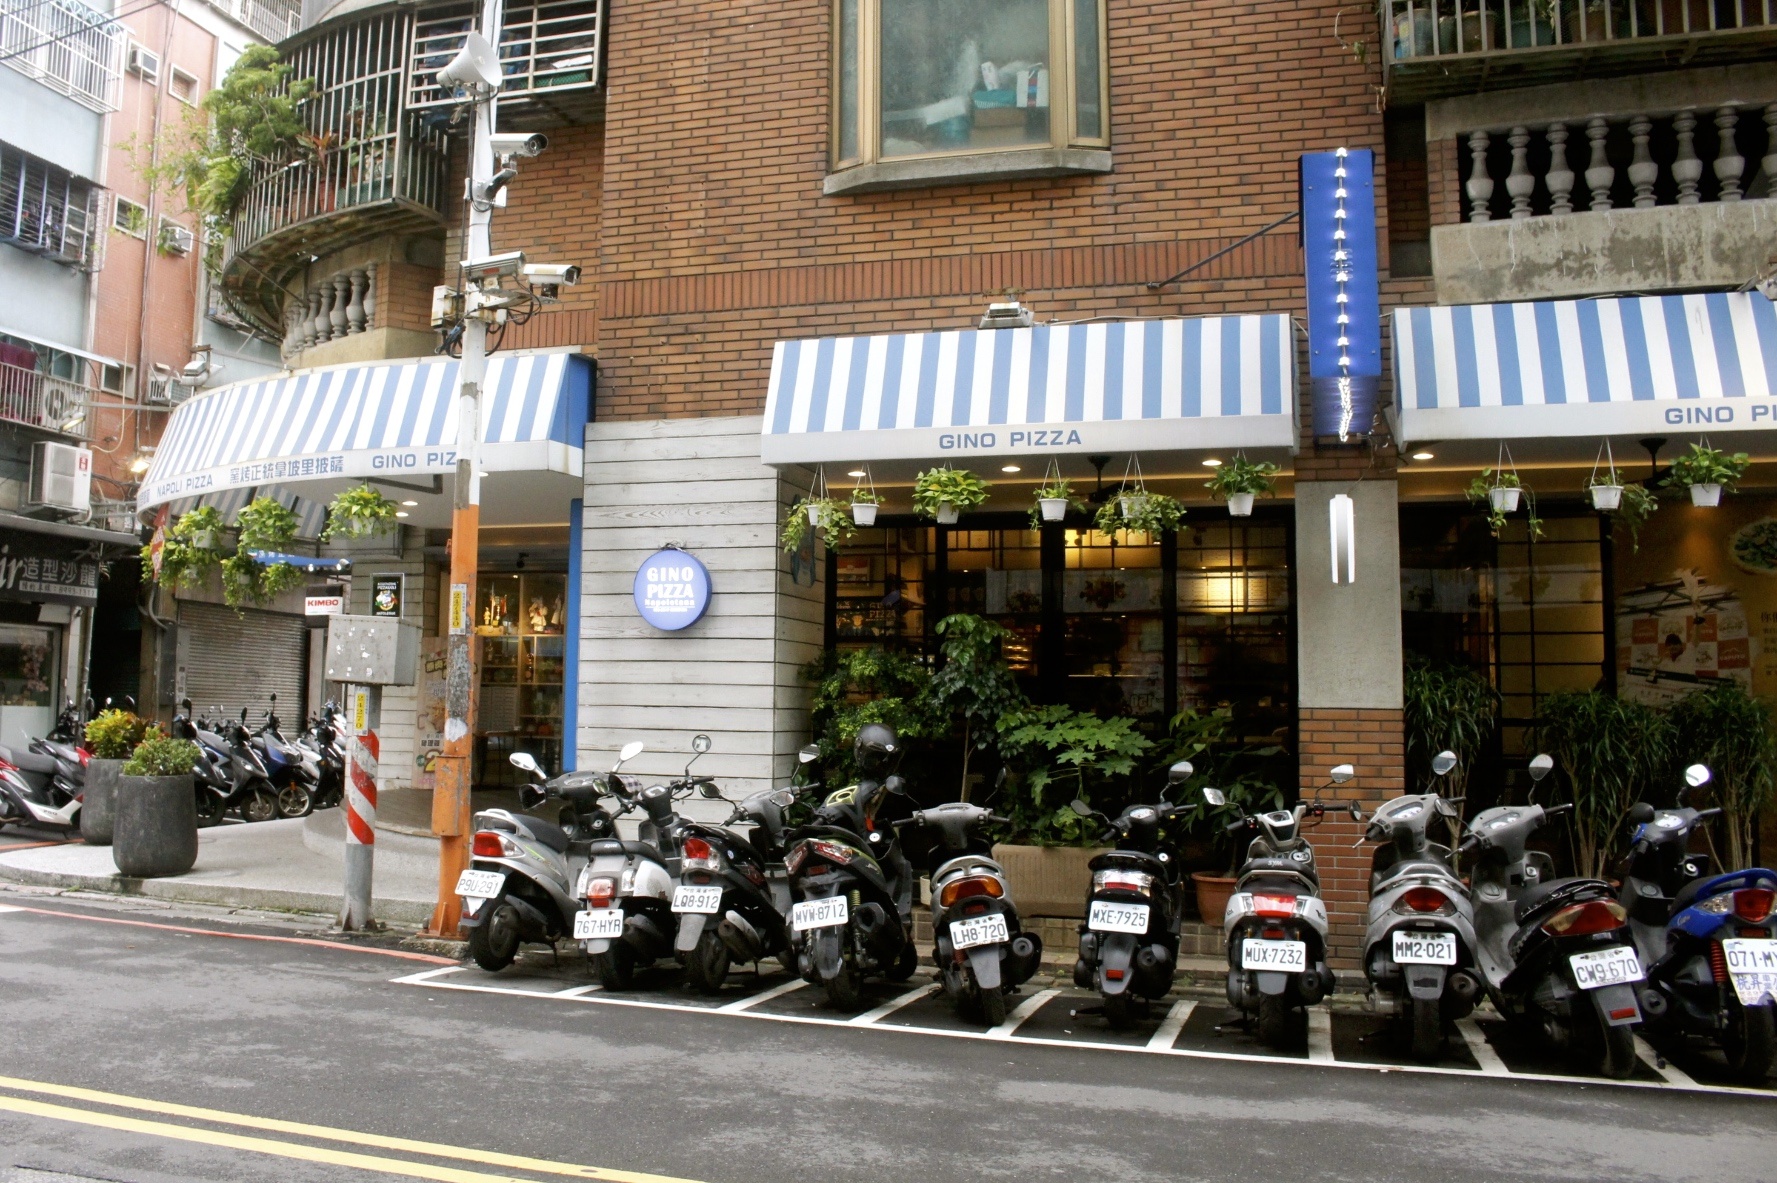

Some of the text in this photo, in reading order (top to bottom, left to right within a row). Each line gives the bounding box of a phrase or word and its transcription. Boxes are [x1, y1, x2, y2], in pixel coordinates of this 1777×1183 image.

[1665, 406, 1734, 425] GINO
[939, 429, 1082, 450] GINO PIZZA
[372, 451, 483, 469] GINO PIZ
[157, 482, 182, 498] NAPOLI
[186, 474, 213, 491] PIZZA
[22, 556, 96, 587] 造型沙龍
[646, 566, 694, 582] GINO
[647, 583, 695, 599] PIZZA
[307, 599, 339, 607] KIMBO
